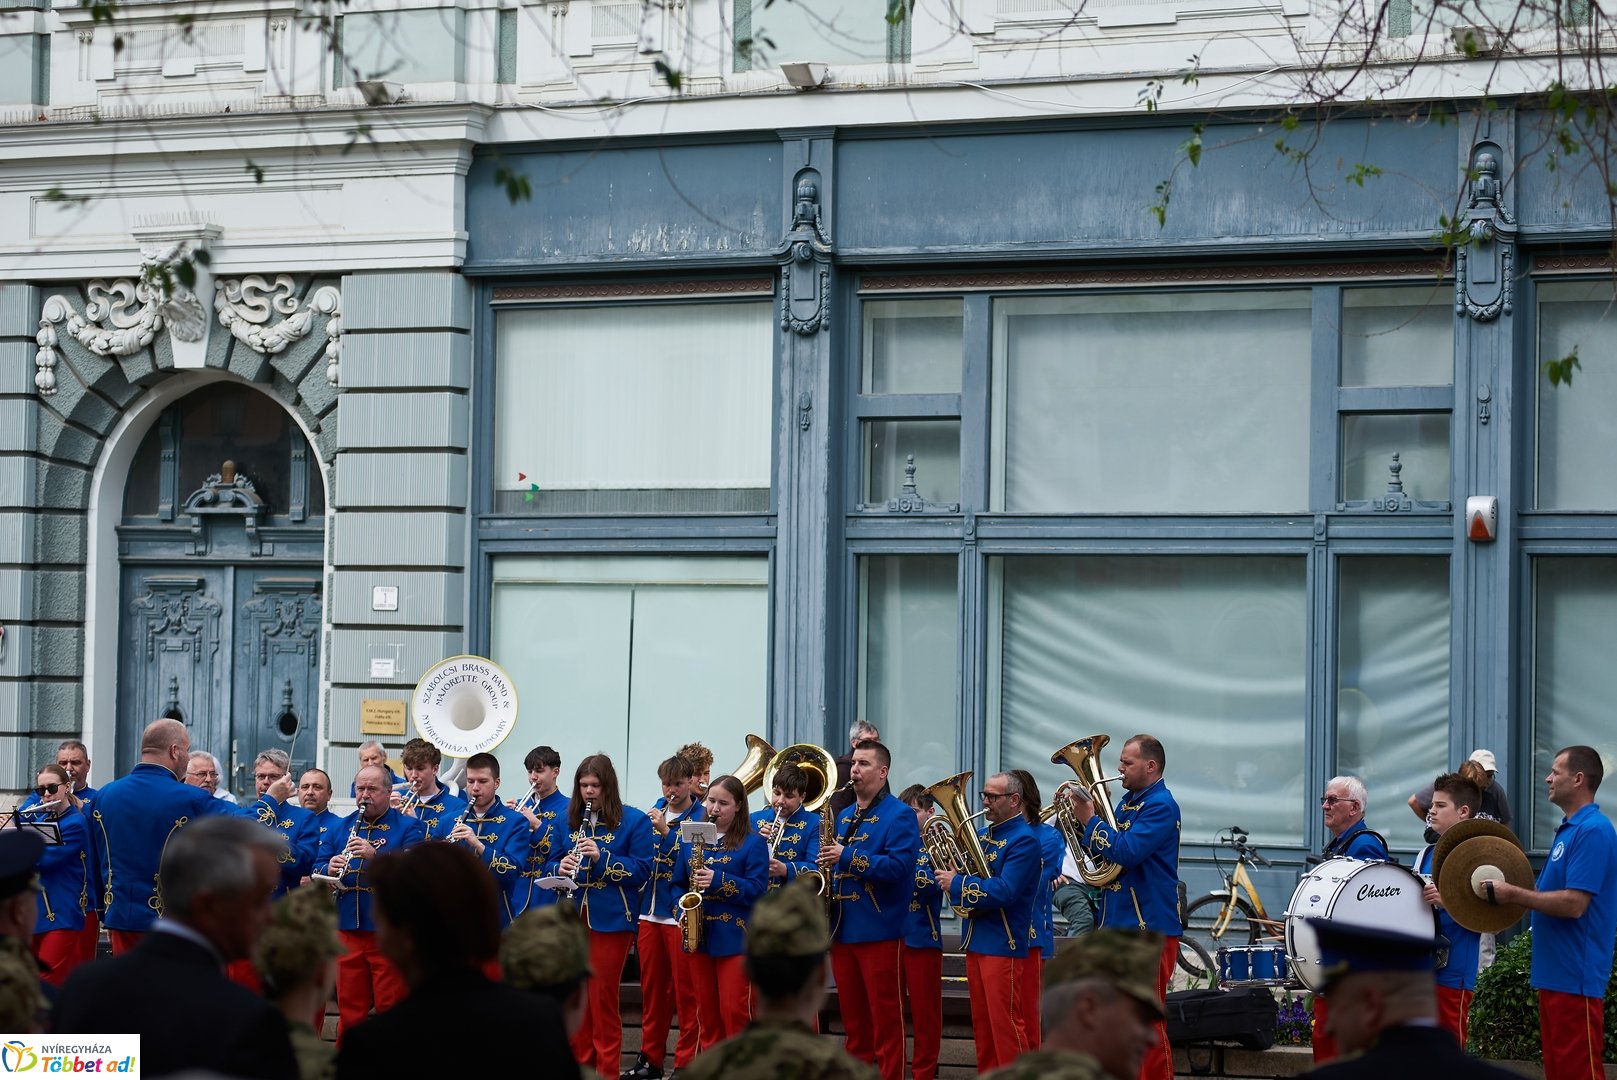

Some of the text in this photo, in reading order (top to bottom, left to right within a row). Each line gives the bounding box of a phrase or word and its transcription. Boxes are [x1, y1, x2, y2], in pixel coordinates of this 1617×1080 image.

[423, 663, 510, 708] SZABOLCSI BRASS BAND &
[435, 675, 499, 709] MAJORETTE GROUP
[475, 719, 507, 751] HUNGARY
[1357, 884, 1401, 901] Chester
